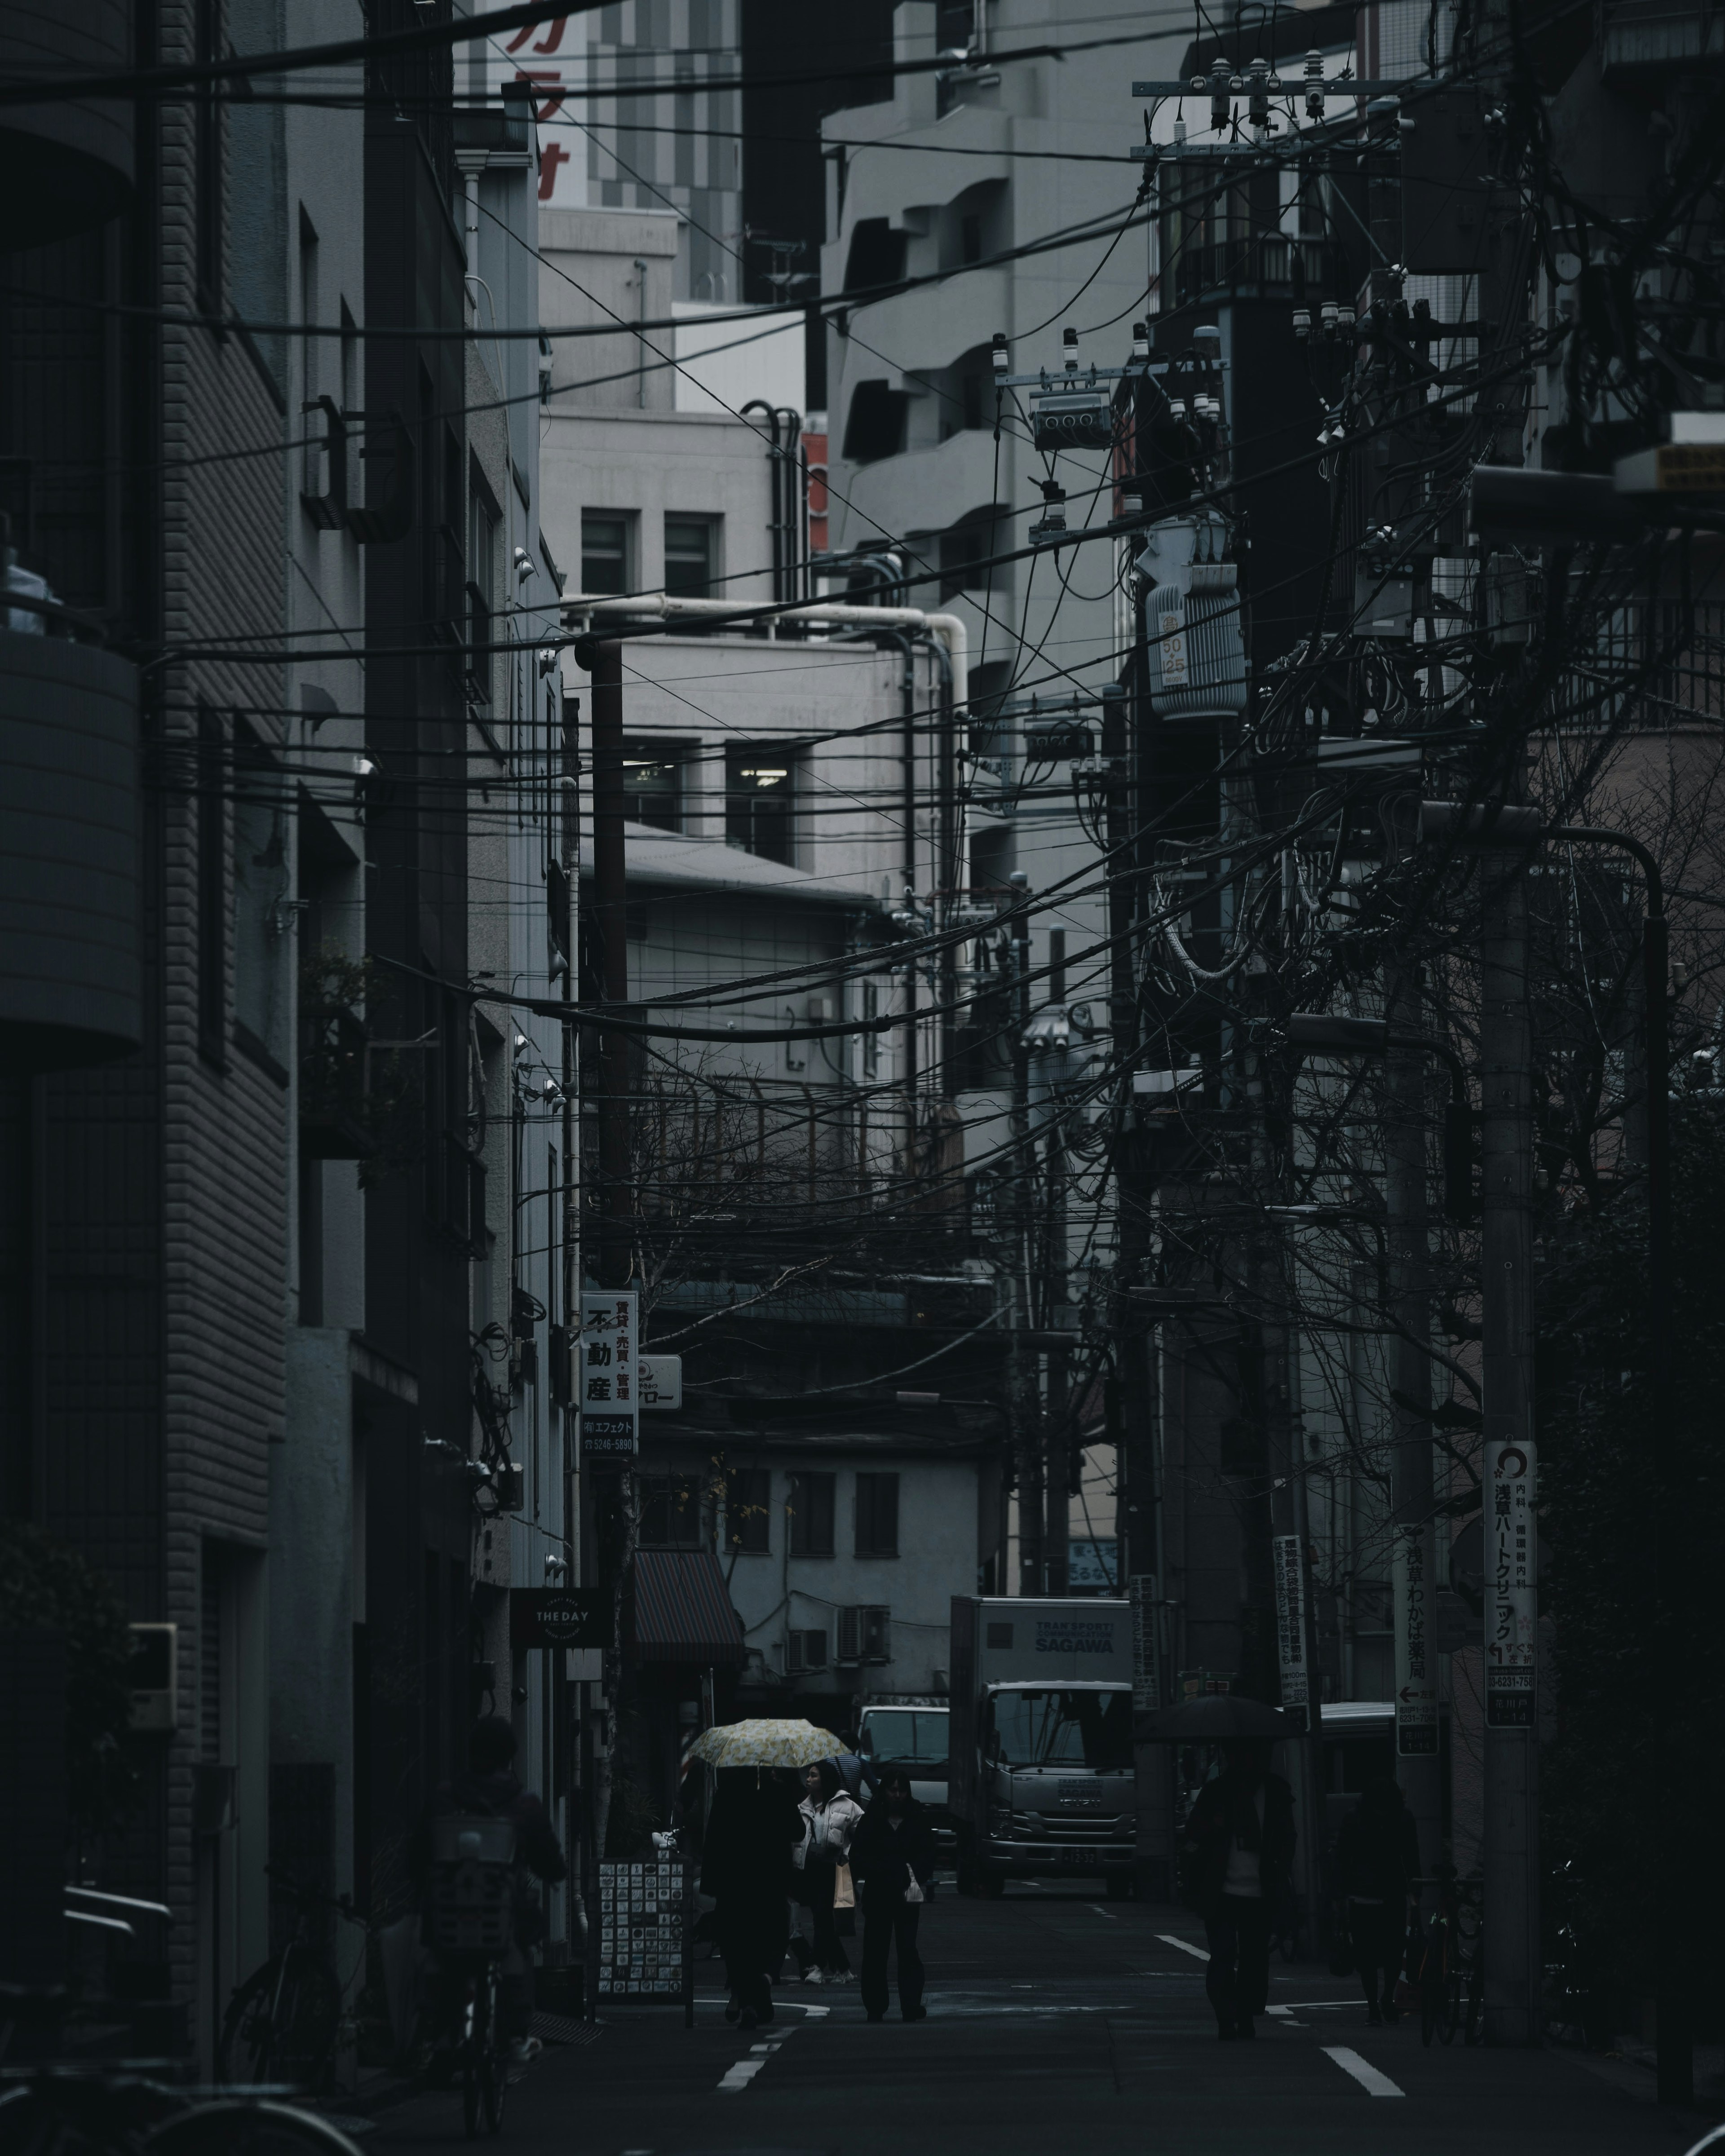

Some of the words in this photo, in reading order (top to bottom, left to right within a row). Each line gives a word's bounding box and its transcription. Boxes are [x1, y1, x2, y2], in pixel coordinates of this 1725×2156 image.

[1163, 638, 1181, 653] 50
[1163, 658, 1184, 674] 125
[588, 1310, 611, 1401] 不動産
[616, 1301, 629, 1400] 賃貸・売買・管理
[638, 1391, 673, 1404] ロー
[594, 1439, 632, 1450] 5246-5890
[1516, 1484, 1526, 1589] 内科・循環器内科
[1495, 1484, 1511, 1641] 浅草ハートクリニック
[1407, 1546, 1426, 1680] 浅草わかば薬局
[1035, 1638, 1114, 1653] SAGAWA
[1509, 1655, 1532, 1664] 左折
[1495, 1699, 1527, 1709] 花川戸
[1496, 1713, 1526, 1721] 1-14
[1060, 1799, 1101, 1807] ISUZU
